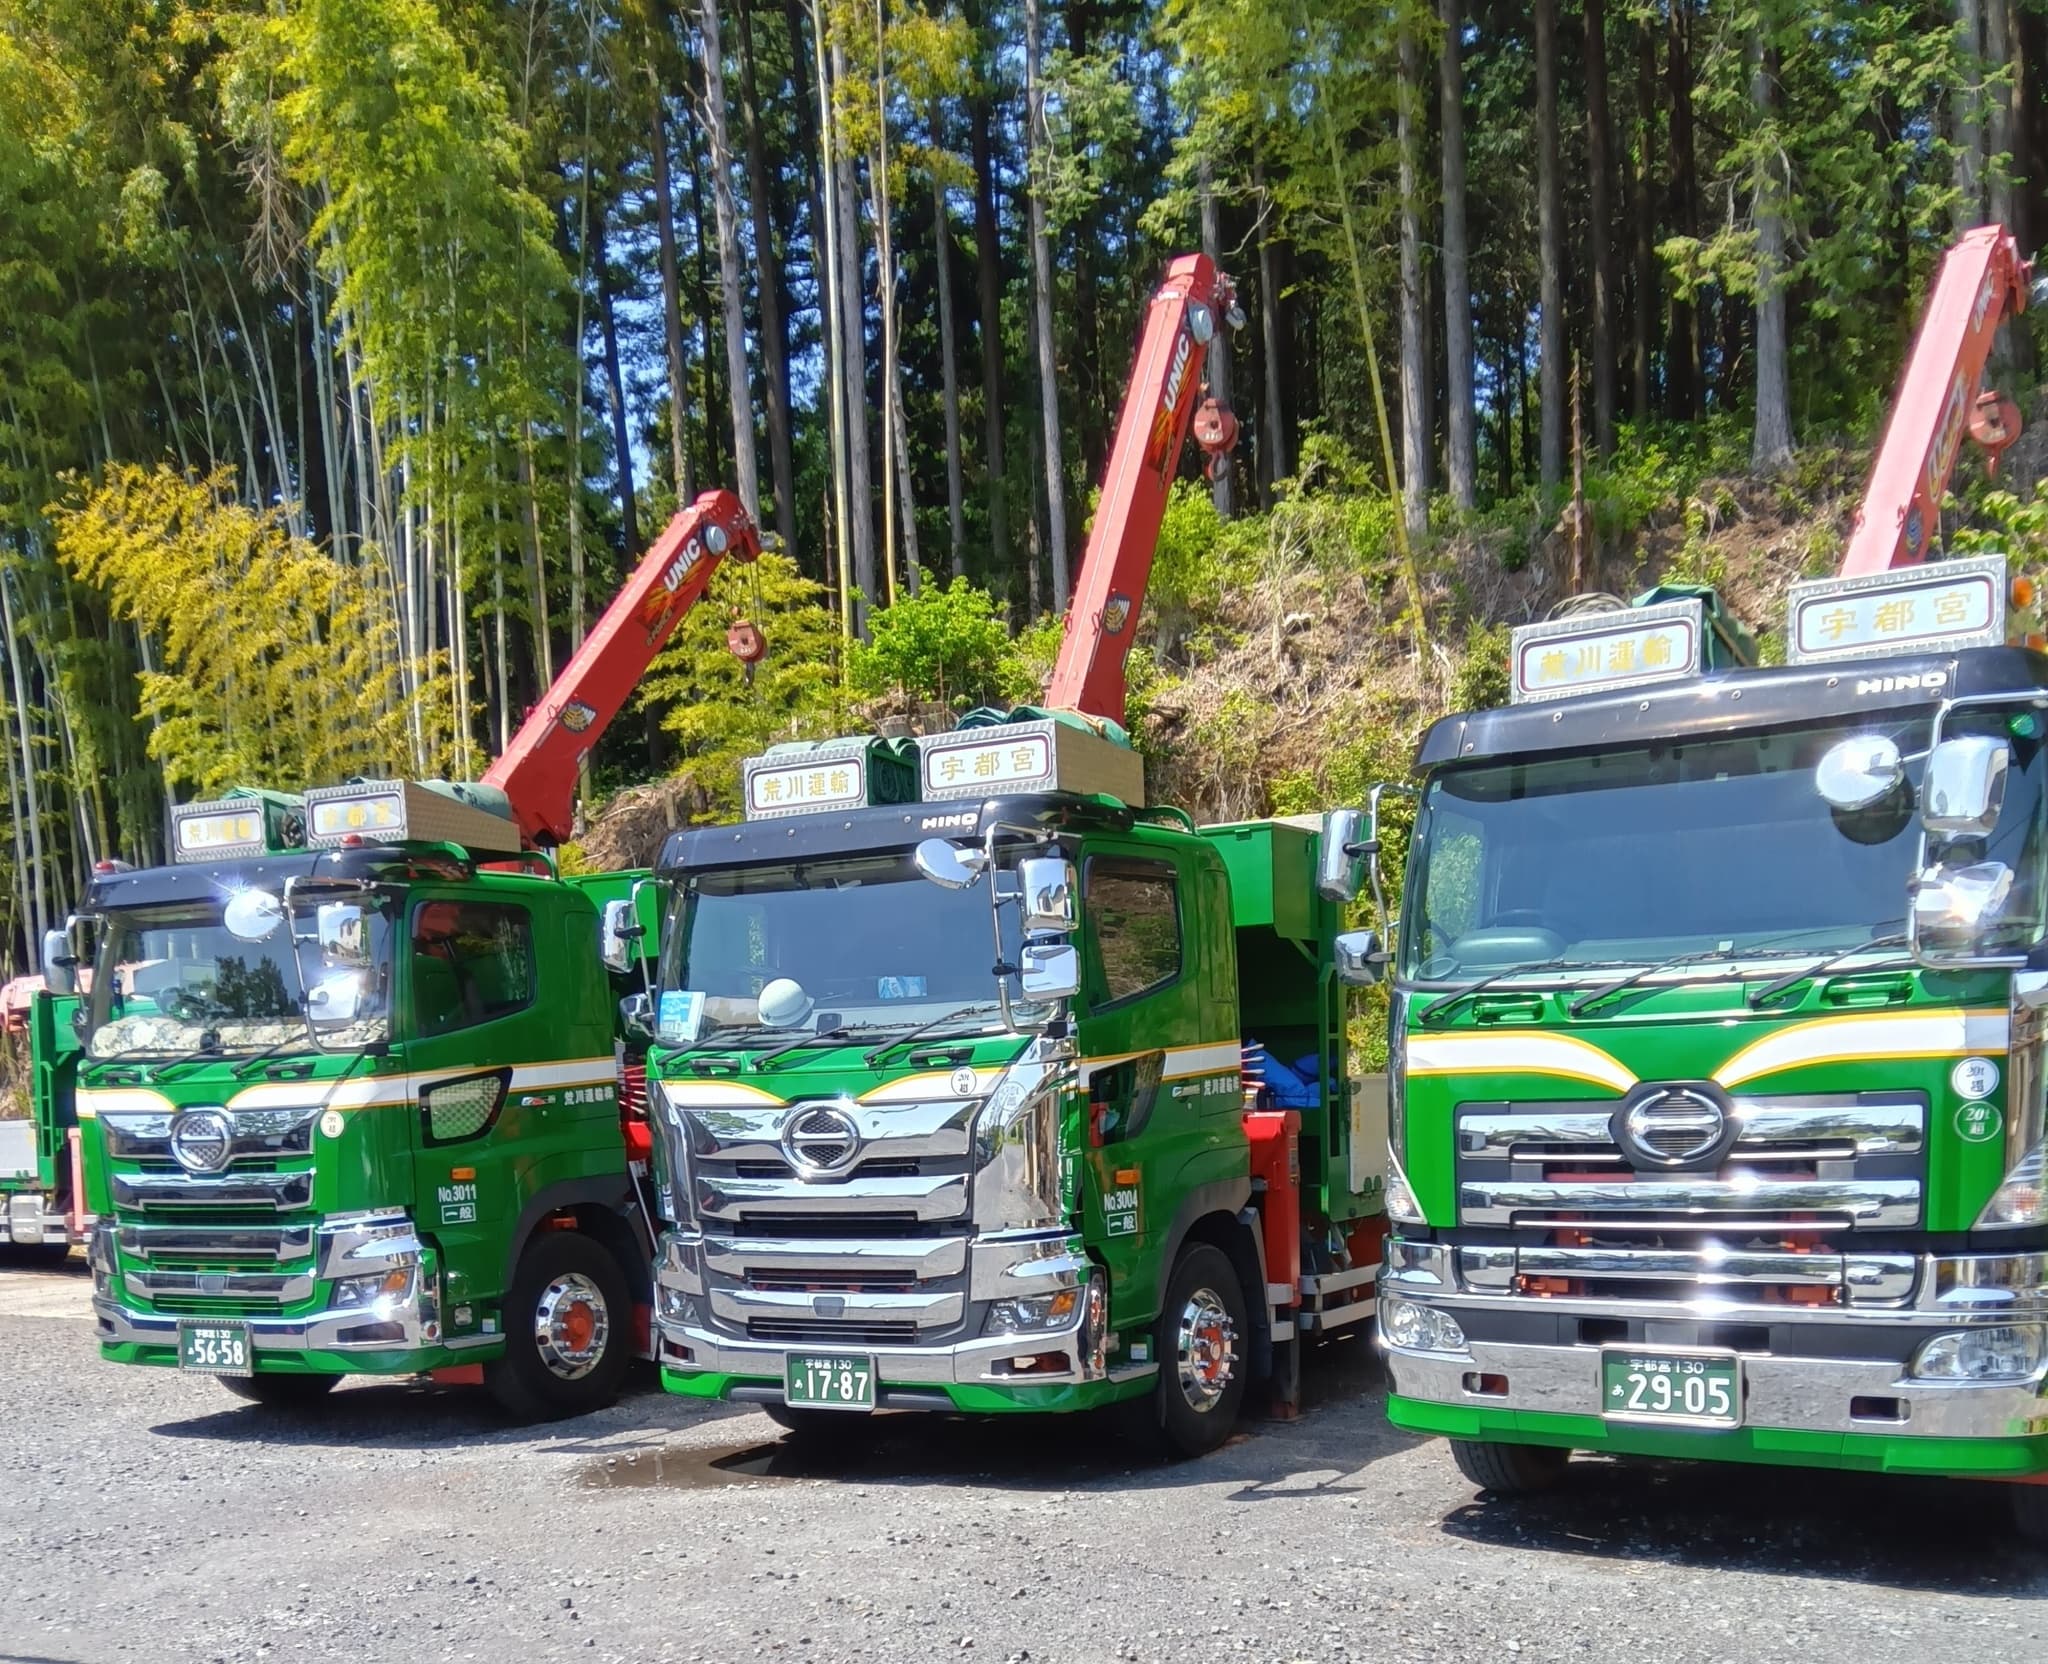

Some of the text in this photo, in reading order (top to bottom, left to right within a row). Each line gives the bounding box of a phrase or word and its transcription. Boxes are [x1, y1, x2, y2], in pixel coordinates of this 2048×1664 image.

[1165, 333, 1189, 411] UNIC
[663, 538, 701, 593] UNIC
[1819, 592, 1971, 640] 宇都宮
[1856, 672, 1947, 695] HINO
[940, 746, 1034, 781] 宇都宮
[763, 770, 850, 802] 荒川運輸
[921, 812, 978, 830] HINO
[194, 1338, 244, 1365] 56-58
[833, 1360, 852, 1370] 130
[1675, 1360, 1705, 1374] 130
[808, 1369, 868, 1401] 17-87
[1611, 1373, 1730, 1415] あ 29-05
